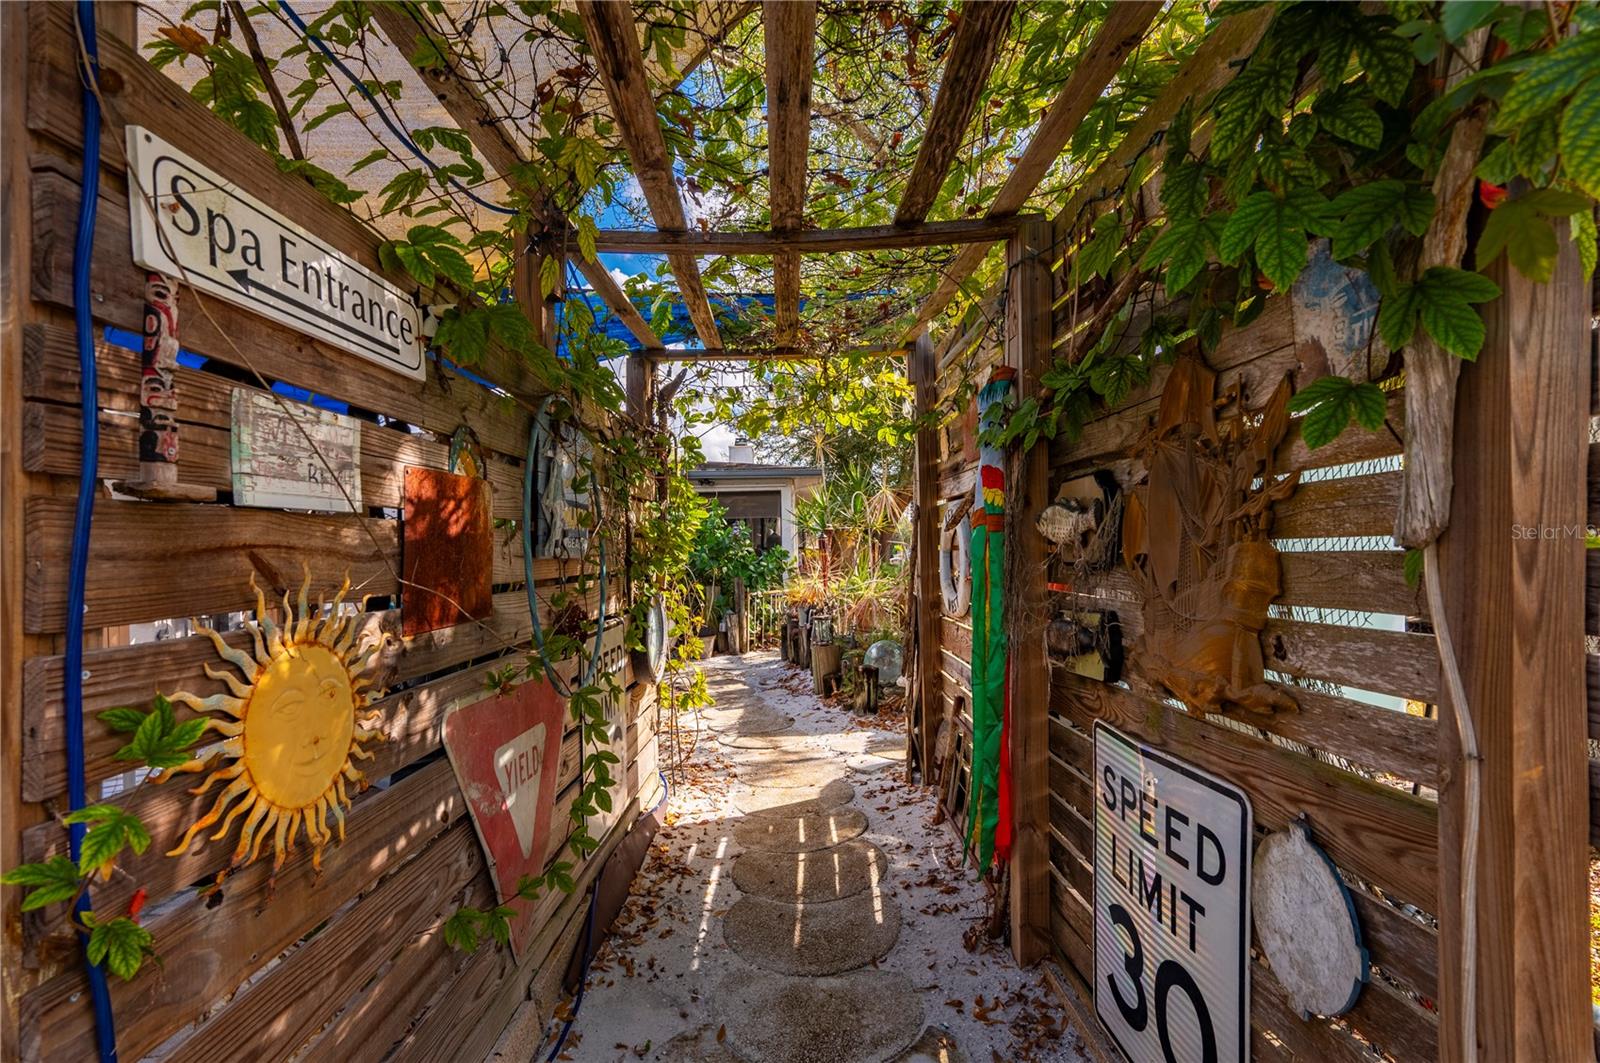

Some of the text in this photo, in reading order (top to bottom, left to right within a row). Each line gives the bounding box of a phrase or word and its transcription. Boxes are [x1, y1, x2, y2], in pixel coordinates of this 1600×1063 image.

[170, 175, 413, 346] Spa Entrance
[504, 745, 540, 794] YIELD
[1102, 765, 1227, 886] SPEED
[1111, 833, 1206, 954] LIMIT
[1106, 903, 1219, 1063] 30
